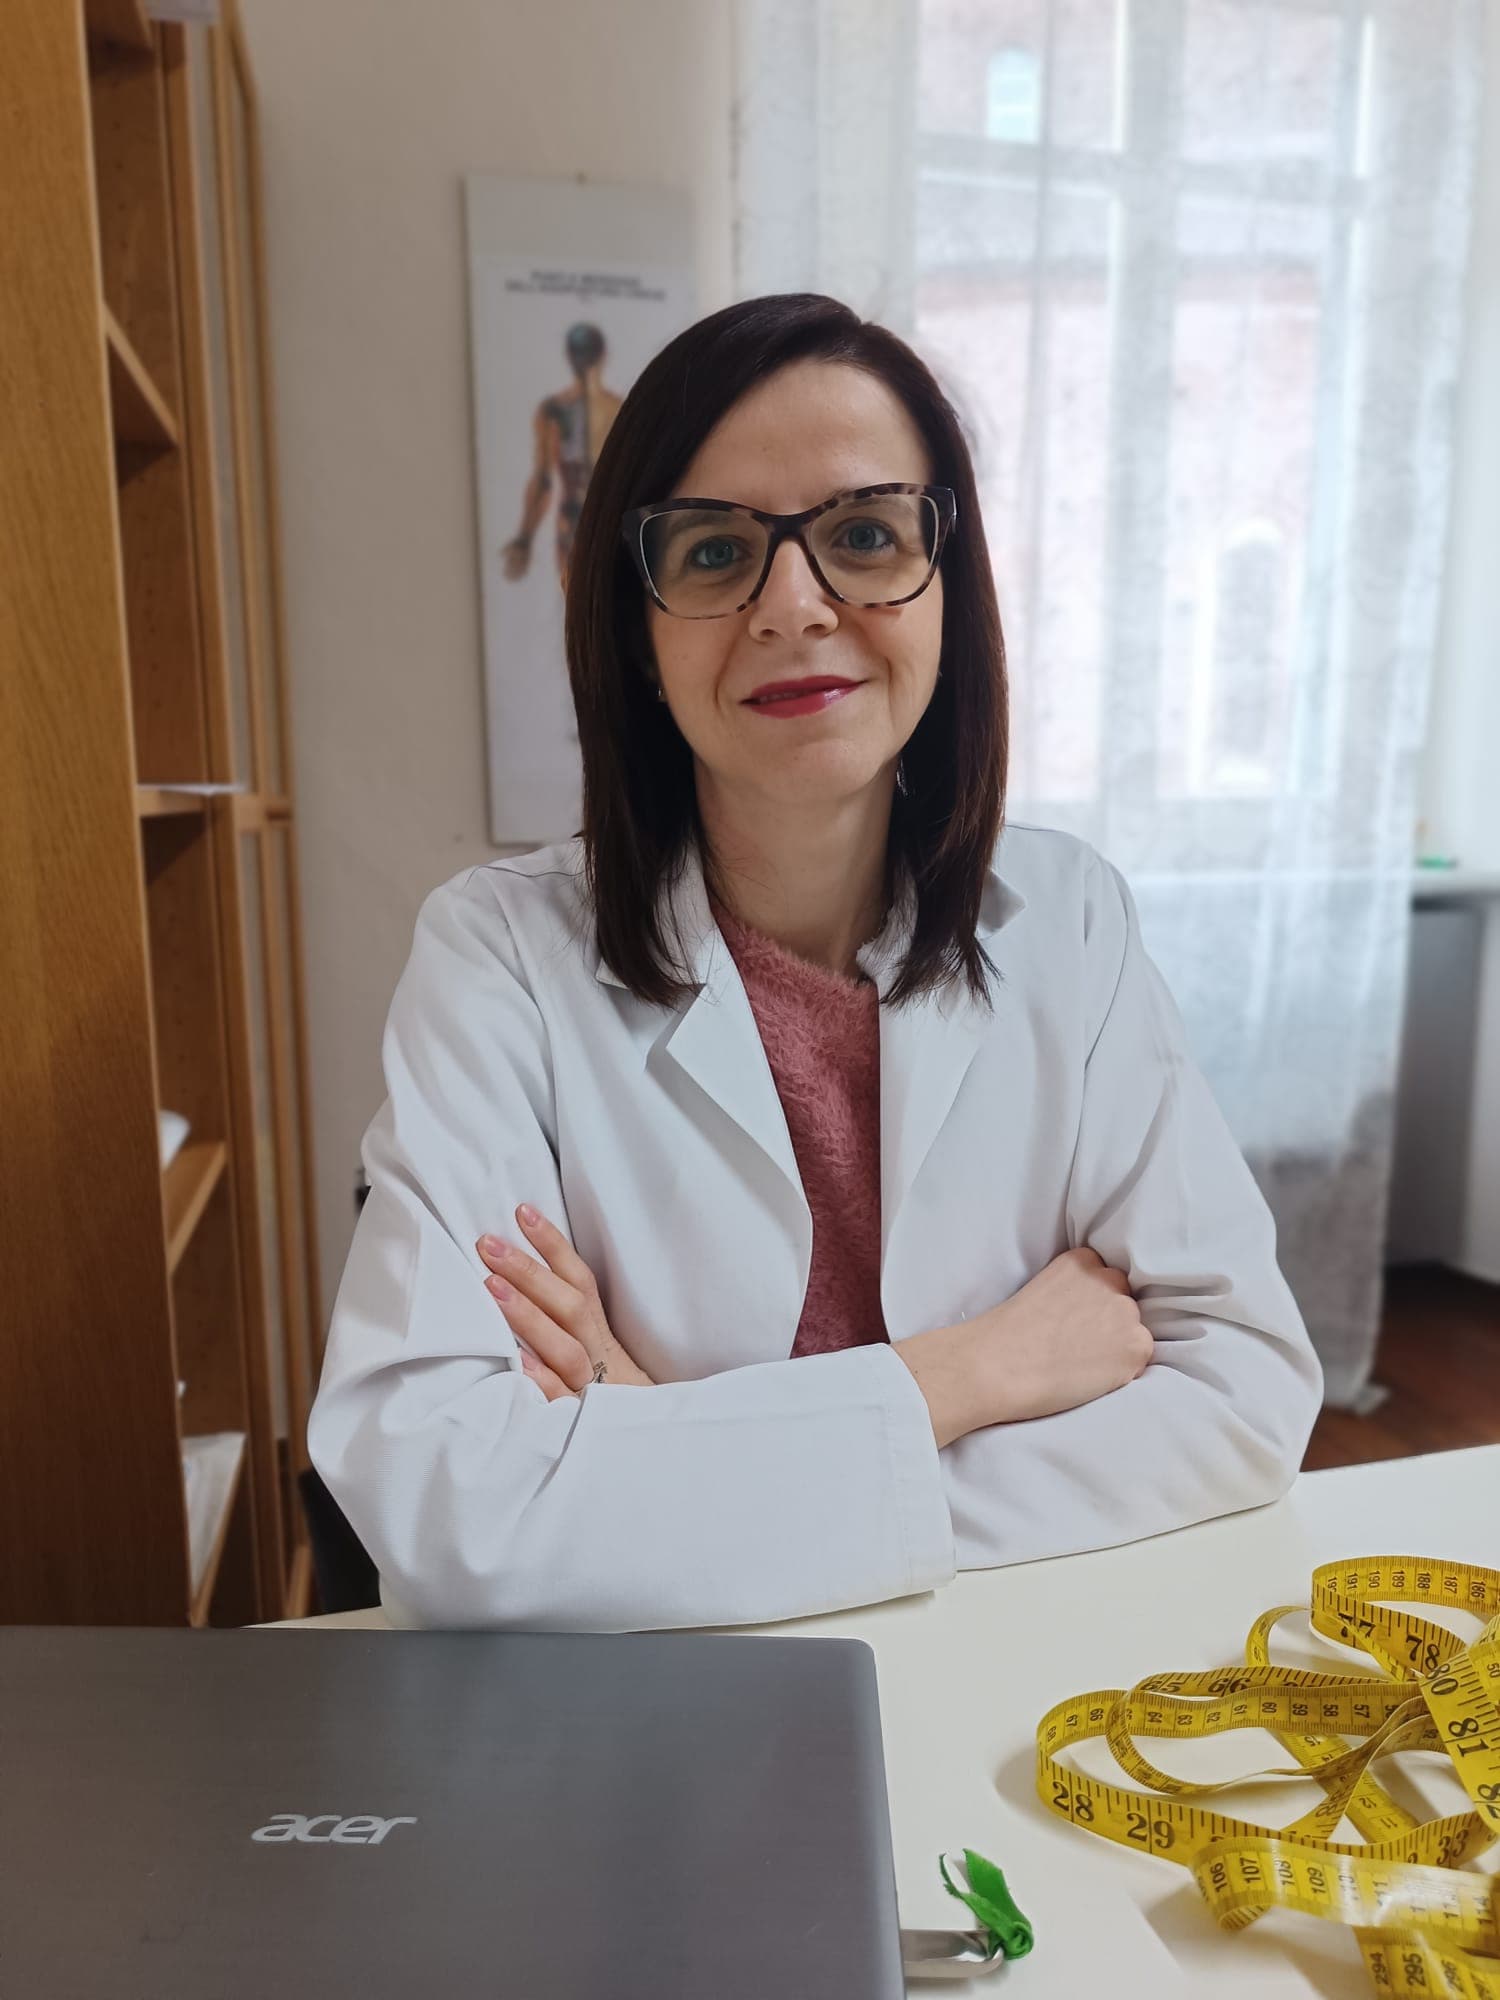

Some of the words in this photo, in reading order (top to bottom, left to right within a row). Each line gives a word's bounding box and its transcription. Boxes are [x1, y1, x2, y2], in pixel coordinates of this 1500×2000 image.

[1347, 1572, 1359, 1590] 191
[1368, 1570, 1381, 1589] 190
[1391, 1569, 1405, 1588] 189
[1417, 1569, 1431, 1590] 188
[1443, 1576, 1458, 1594] 187
[1471, 1579, 1486, 1599] 186
[1406, 1635, 1440, 1671] 78
[1208, 1677, 1250, 1693] 66
[1426, 1663, 1459, 1695] 80
[1066, 1714, 1078, 1727] 67
[1090, 1708, 1104, 1722] 66
[1177, 1714, 1193, 1726] 63
[1206, 1711, 1221, 1723] 62
[1234, 1704, 1248, 1715] 61
[1262, 1702, 1277, 1713] 60
[1292, 1703, 1308, 1716] 59
[1323, 1704, 1339, 1717] 58
[1354, 1704, 1370, 1718] 57
[1448, 1717, 1489, 1758] 81
[251, 1814, 418, 1844] acer
[1053, 1781, 1094, 1822] 28
[1126, 1812, 1175, 1849] 29
[1436, 1829, 1469, 1864] 33
[1210, 1862, 1228, 1893] 106
[1240, 1857, 1261, 1884] 107
[1307, 1867, 1326, 1894] 109
[1402, 1953, 1426, 1987] 295
